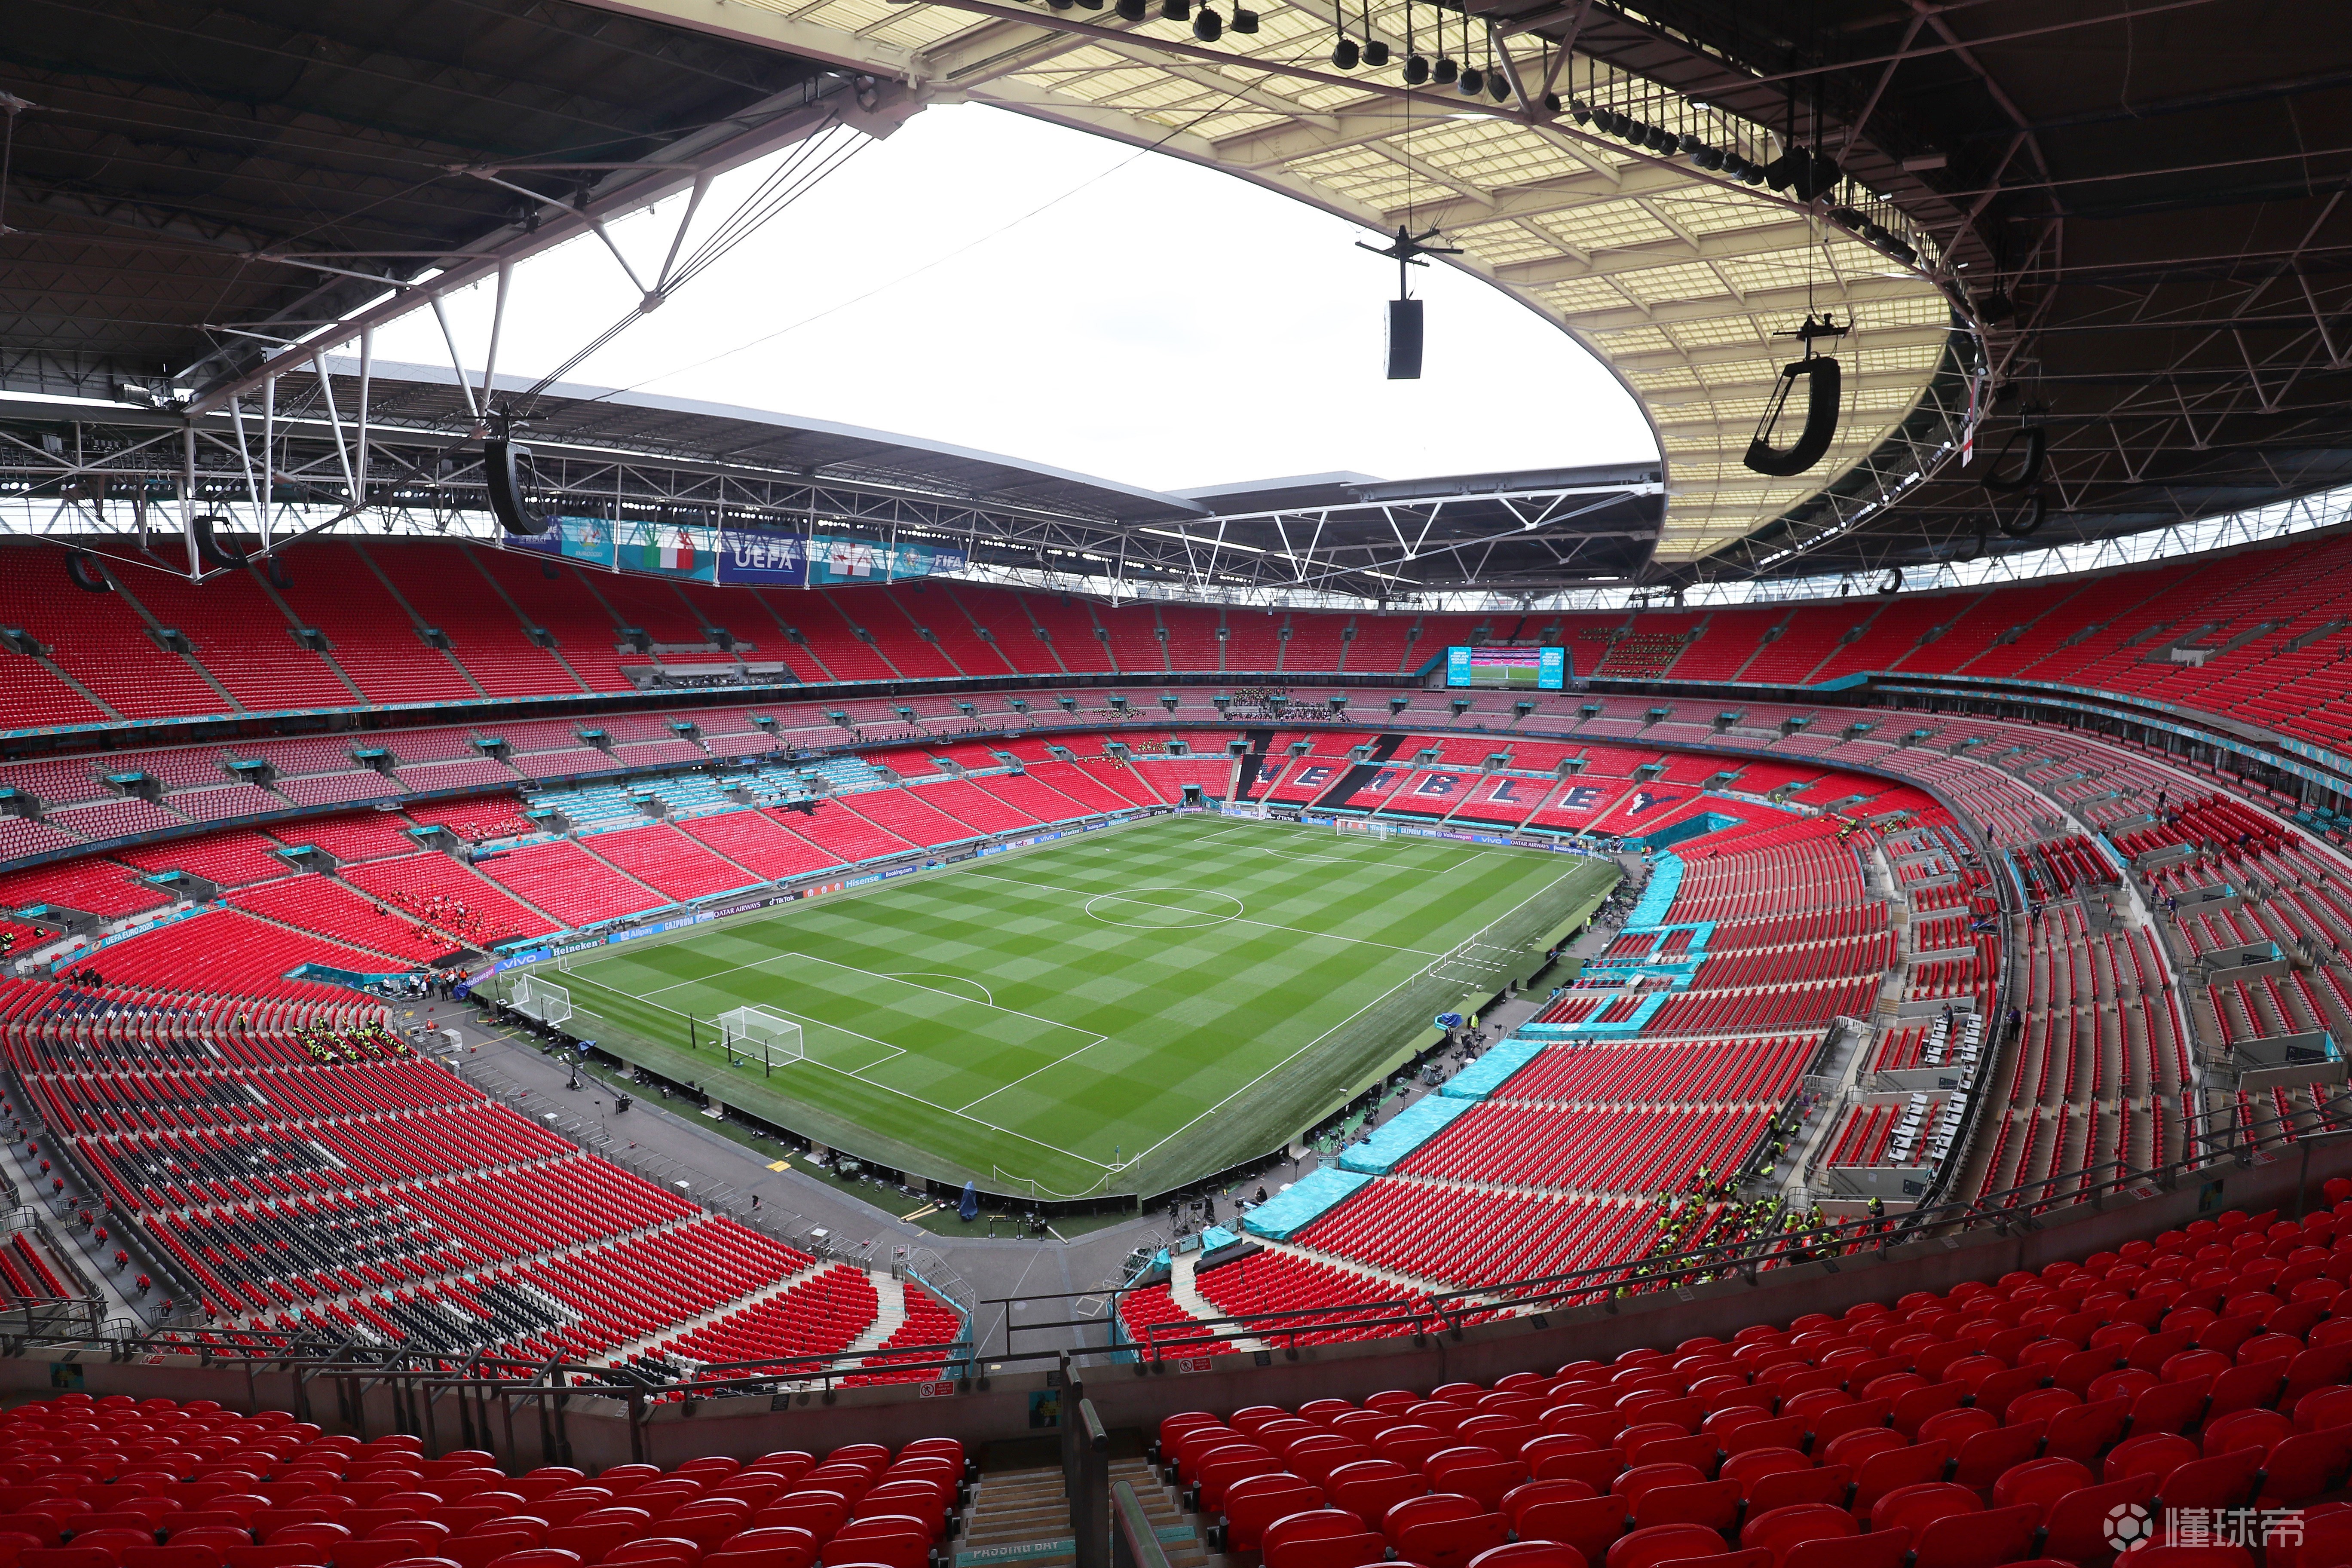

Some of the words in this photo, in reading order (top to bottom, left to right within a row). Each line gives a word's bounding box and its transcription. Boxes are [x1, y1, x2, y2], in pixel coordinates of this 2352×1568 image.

[735, 547, 793, 570] UEFA
[935, 554, 961, 568] FIFA
[1109, 818, 1128, 827] Hisense
[1061, 829, 1080, 837] Heineken
[86, 838, 121, 851] LONDON
[1554, 845, 1582, 854] Booking.com
[885, 866, 913, 877] Booking.com
[846, 875, 879, 888] Hisense
[775, 895, 794, 904] TikTok
[714, 908, 734, 917] QATAR
[735, 902, 761, 913] AIRWAYS
[665, 916, 694, 931] GAZPROM
[105, 934, 122, 945] UEFA
[122, 928, 139, 939] EURO
[139, 922, 154, 933] 2020
[631, 927, 653, 938] Alipay
[553, 940, 597, 956] Heineken
[503, 953, 536, 969] vivo
[467, 968, 494, 986] Volkswagen
